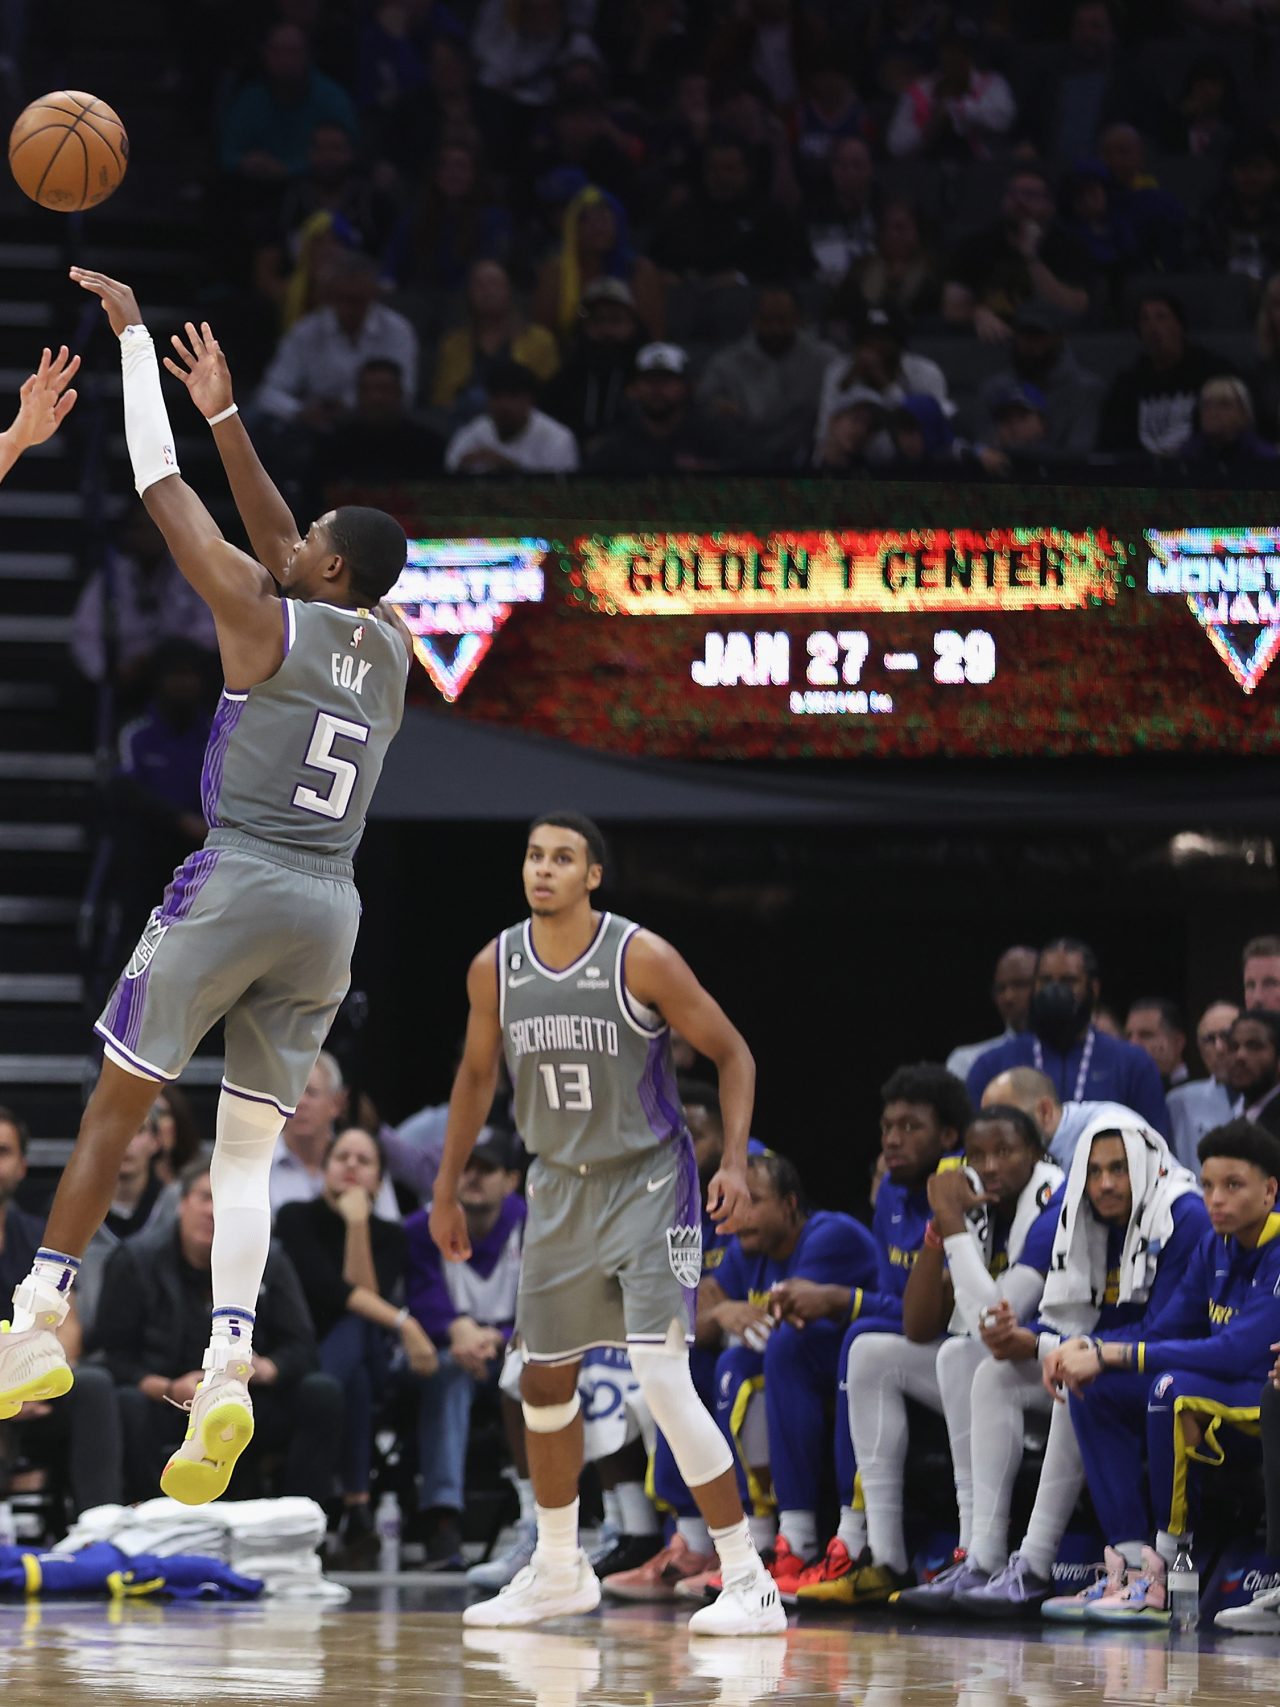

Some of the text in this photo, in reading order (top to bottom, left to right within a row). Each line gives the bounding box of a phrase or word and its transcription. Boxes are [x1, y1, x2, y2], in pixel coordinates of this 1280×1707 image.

[380, 567, 544, 603] ONSTER
[628, 547, 809, 594] GOLDEN
[881, 544, 1066, 592] CENTER
[330, 652, 372, 696] FOX
[691, 631, 790, 687] JAN
[806, 630, 869, 686] 27
[933, 629, 996, 685] 29
[291, 709, 371, 822] 5
[508, 1013, 619, 1057] SACRAMENTO
[538, 1062, 593, 1112] 13
